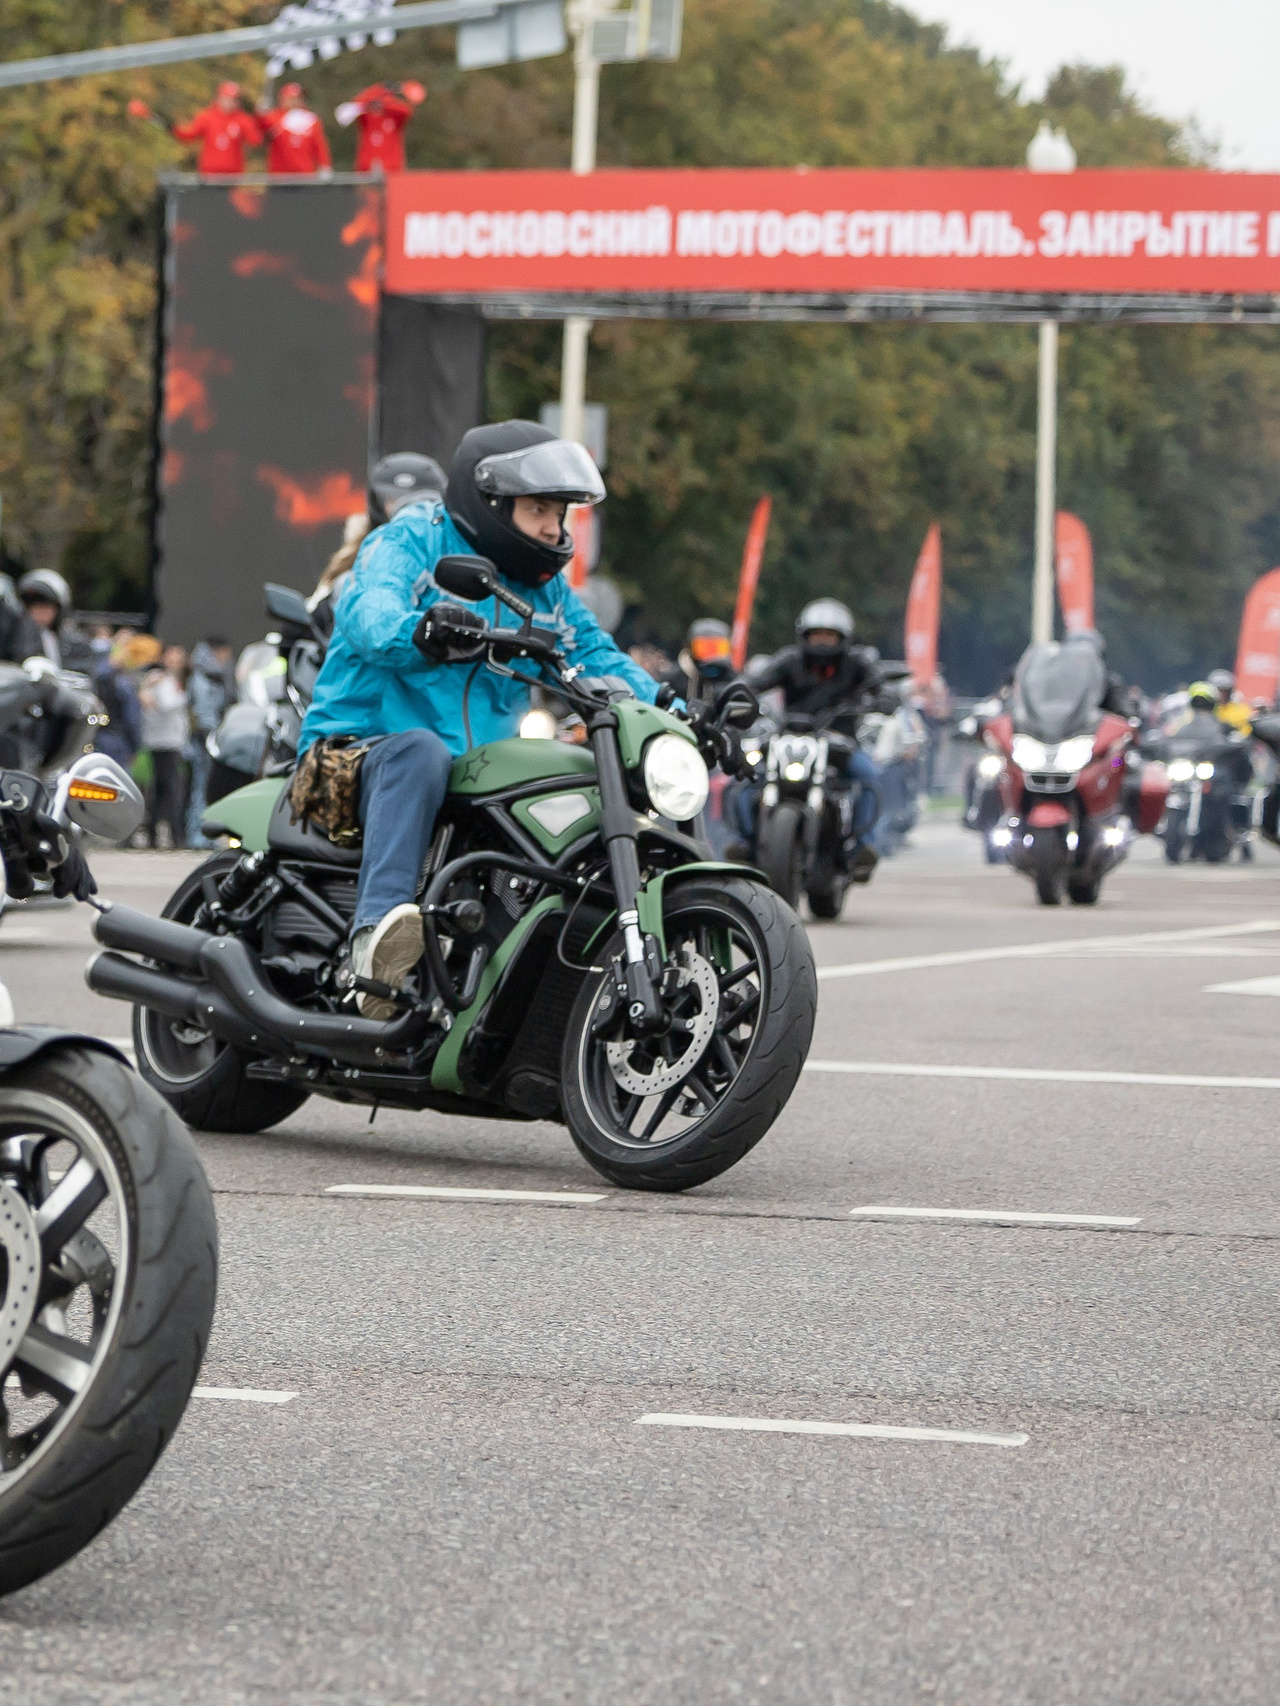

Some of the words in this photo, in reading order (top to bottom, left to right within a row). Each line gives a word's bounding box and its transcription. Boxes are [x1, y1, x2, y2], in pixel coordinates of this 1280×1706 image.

[405, 207, 672, 258] МОСКОВСКИЙ
[676, 210, 1035, 257] МОТОФЕСТИВАЛЬ.
[1039, 210, 1260, 258] ЗАКРЫТИЕ
